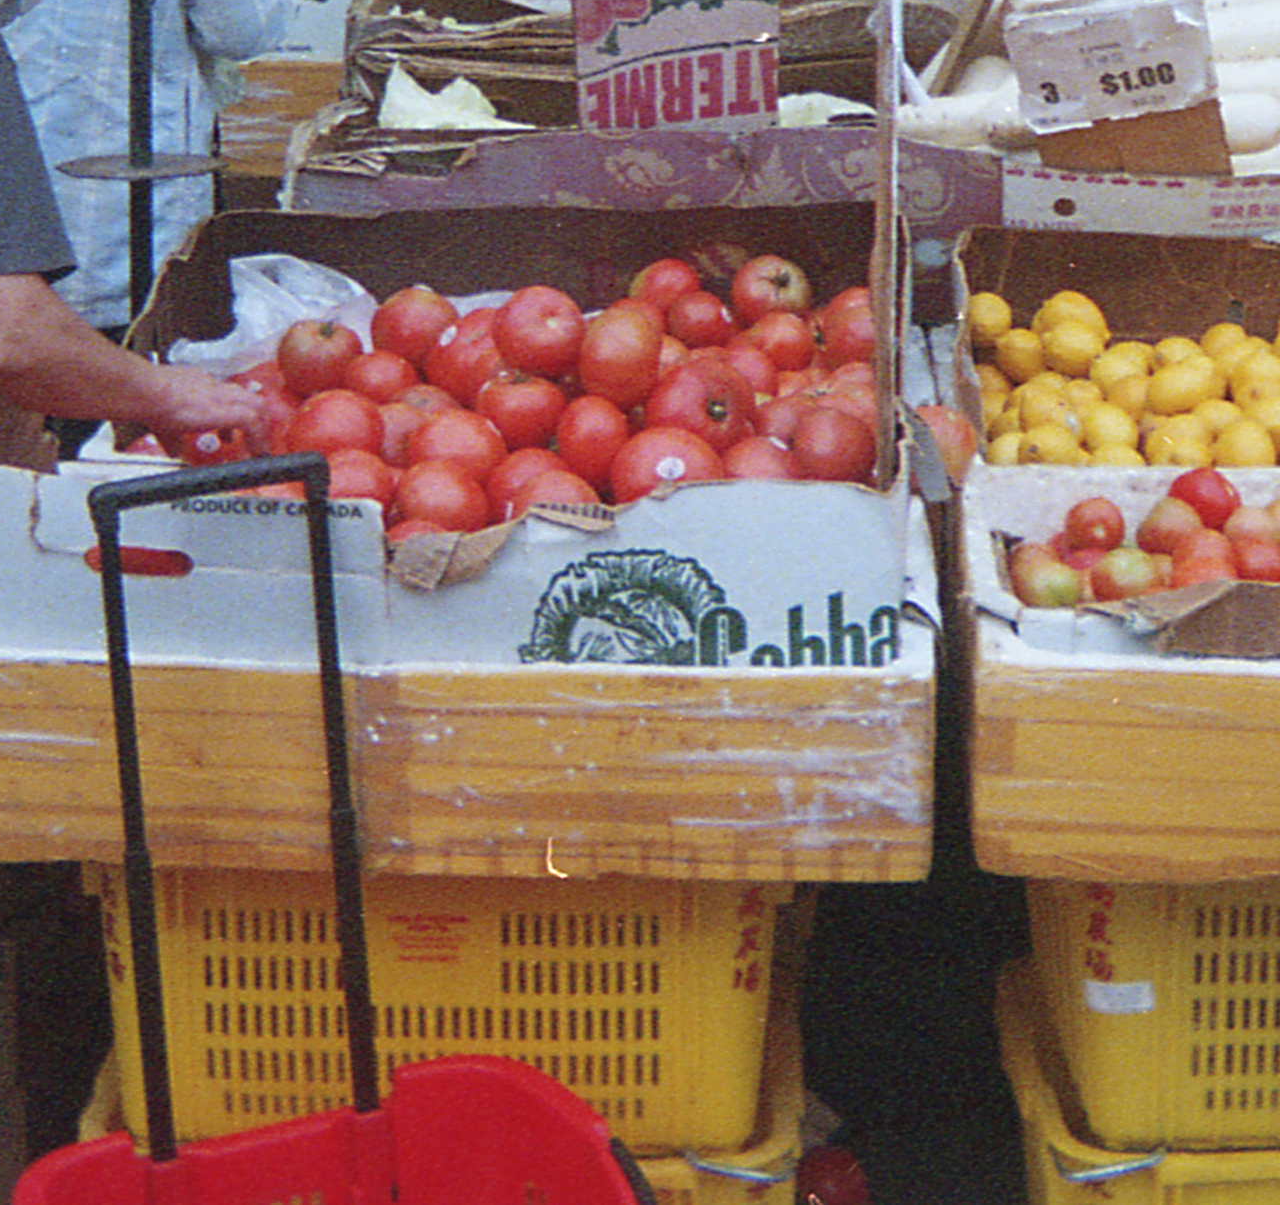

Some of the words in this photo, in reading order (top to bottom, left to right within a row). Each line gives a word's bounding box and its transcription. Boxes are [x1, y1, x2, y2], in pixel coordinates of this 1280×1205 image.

[1039, 81, 1062, 106] 3
[1098, 61, 1177, 96] $1.00
[171, 499, 252, 516] PRODUCE
[257, 500, 282, 516] OF
[284, 501, 364, 520] CAADA
